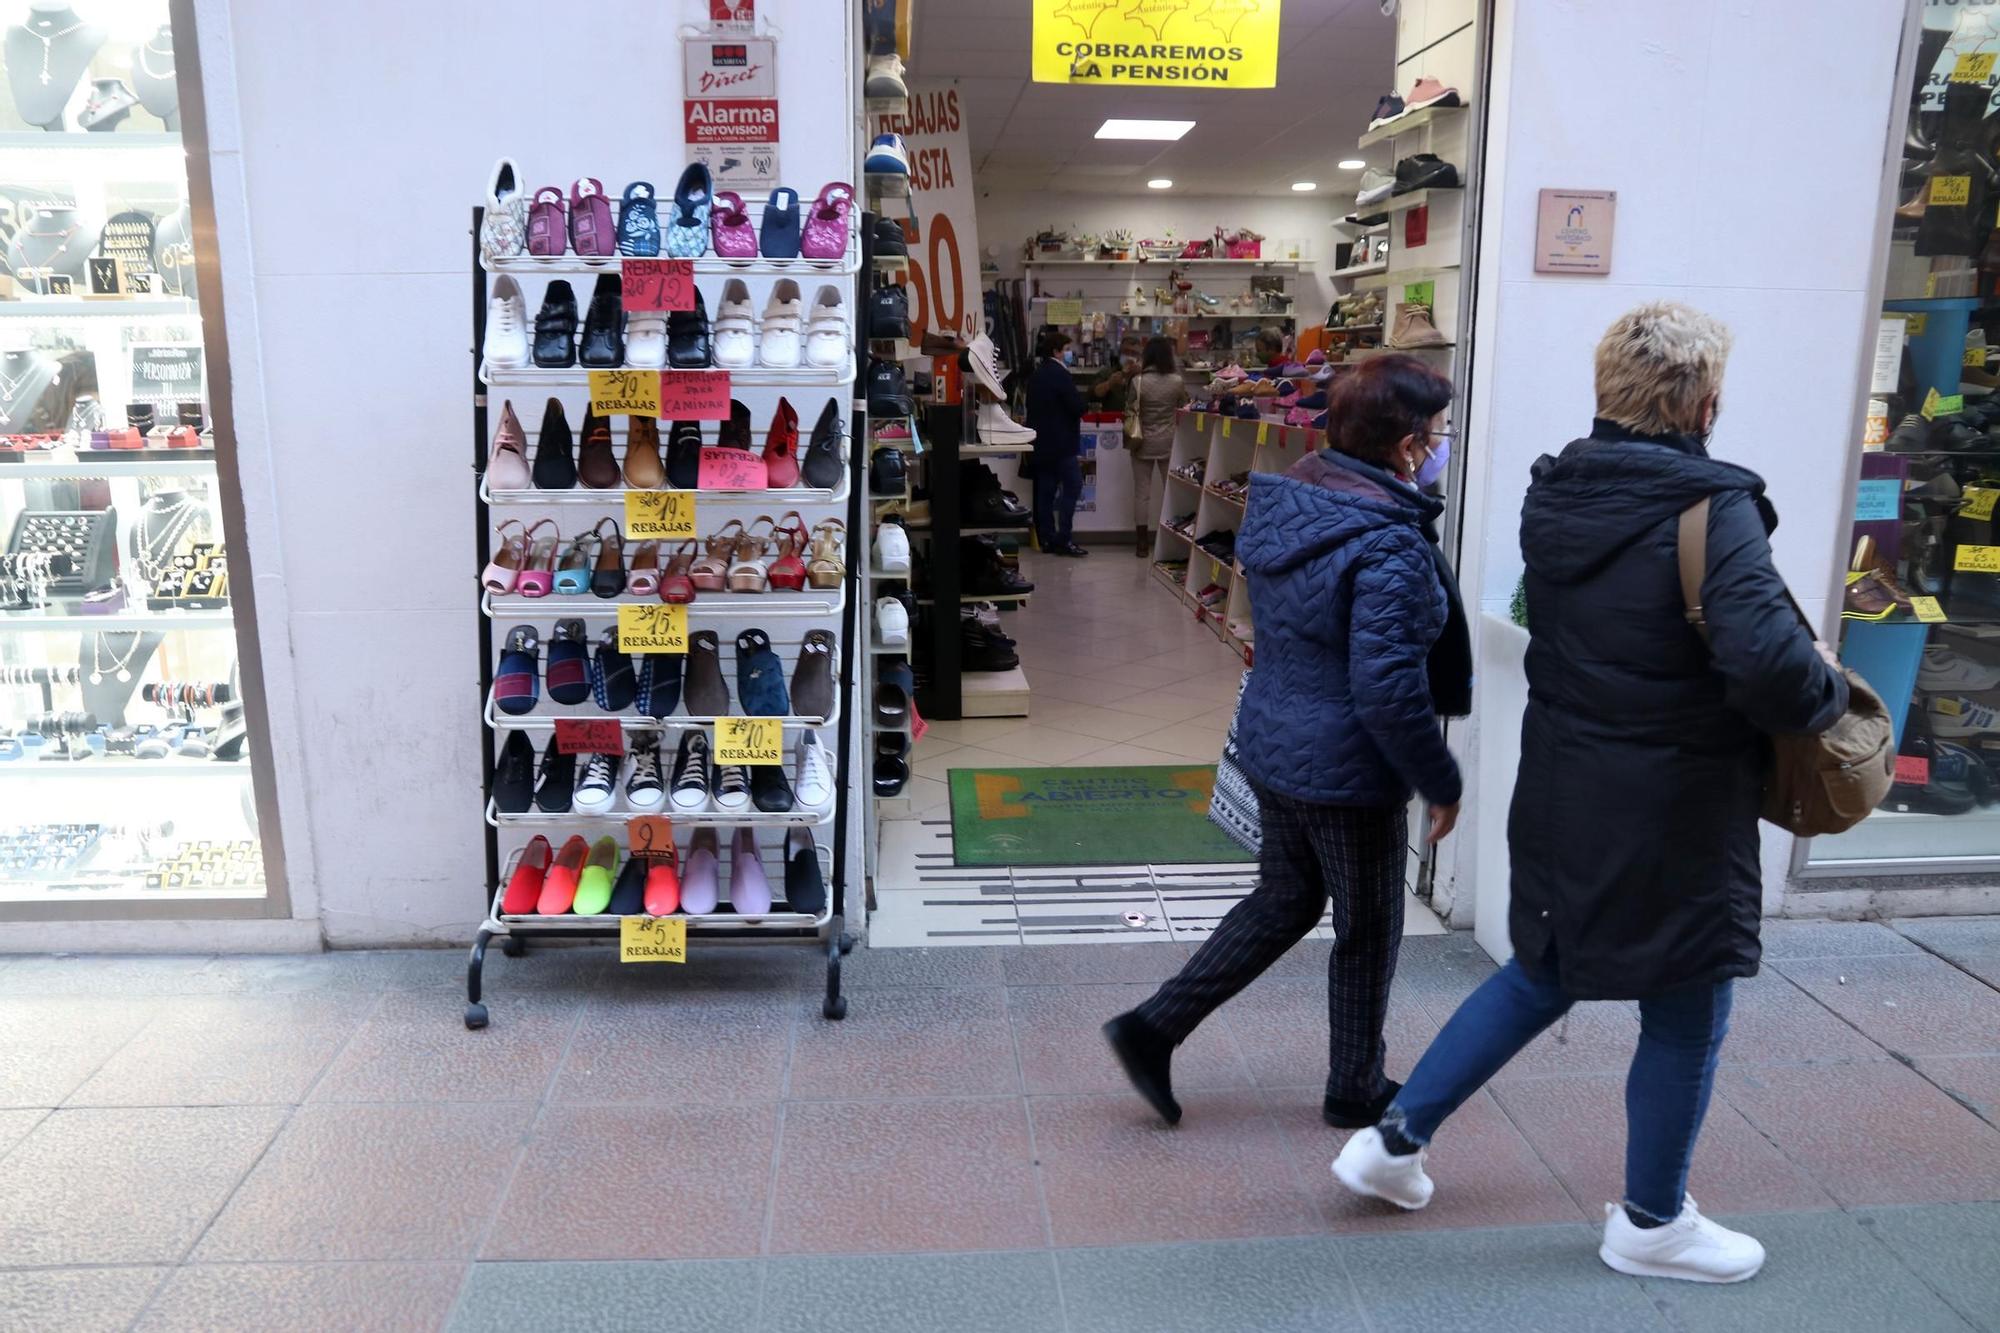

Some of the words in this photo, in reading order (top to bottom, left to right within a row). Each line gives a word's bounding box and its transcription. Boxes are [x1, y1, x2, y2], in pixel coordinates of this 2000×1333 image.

[1056, 42, 1243, 61] COBRAREMOS
[699, 64, 763, 93] Direct
[1071, 64, 1102, 78] LA
[1111, 63, 1229, 81] PENSIÓN
[688, 102, 776, 124] Alarma
[697, 125, 767, 136] zerovision
[909, 147, 954, 191] ASTA
[623, 260, 692, 277] REBAJAS
[595, 400, 656, 410] REBAJAS
[631, 522, 692, 532] REBAJAS
[649, 611, 671, 635] 15
[623, 636, 683, 647] REBAJAS
[745, 723, 763, 748] 10
[720, 749, 778, 759] REBAJAS
[1016, 788, 1191, 801] ABIERTO
[655, 924, 666, 945] 5
[626, 947, 682, 957] REBAJAS
